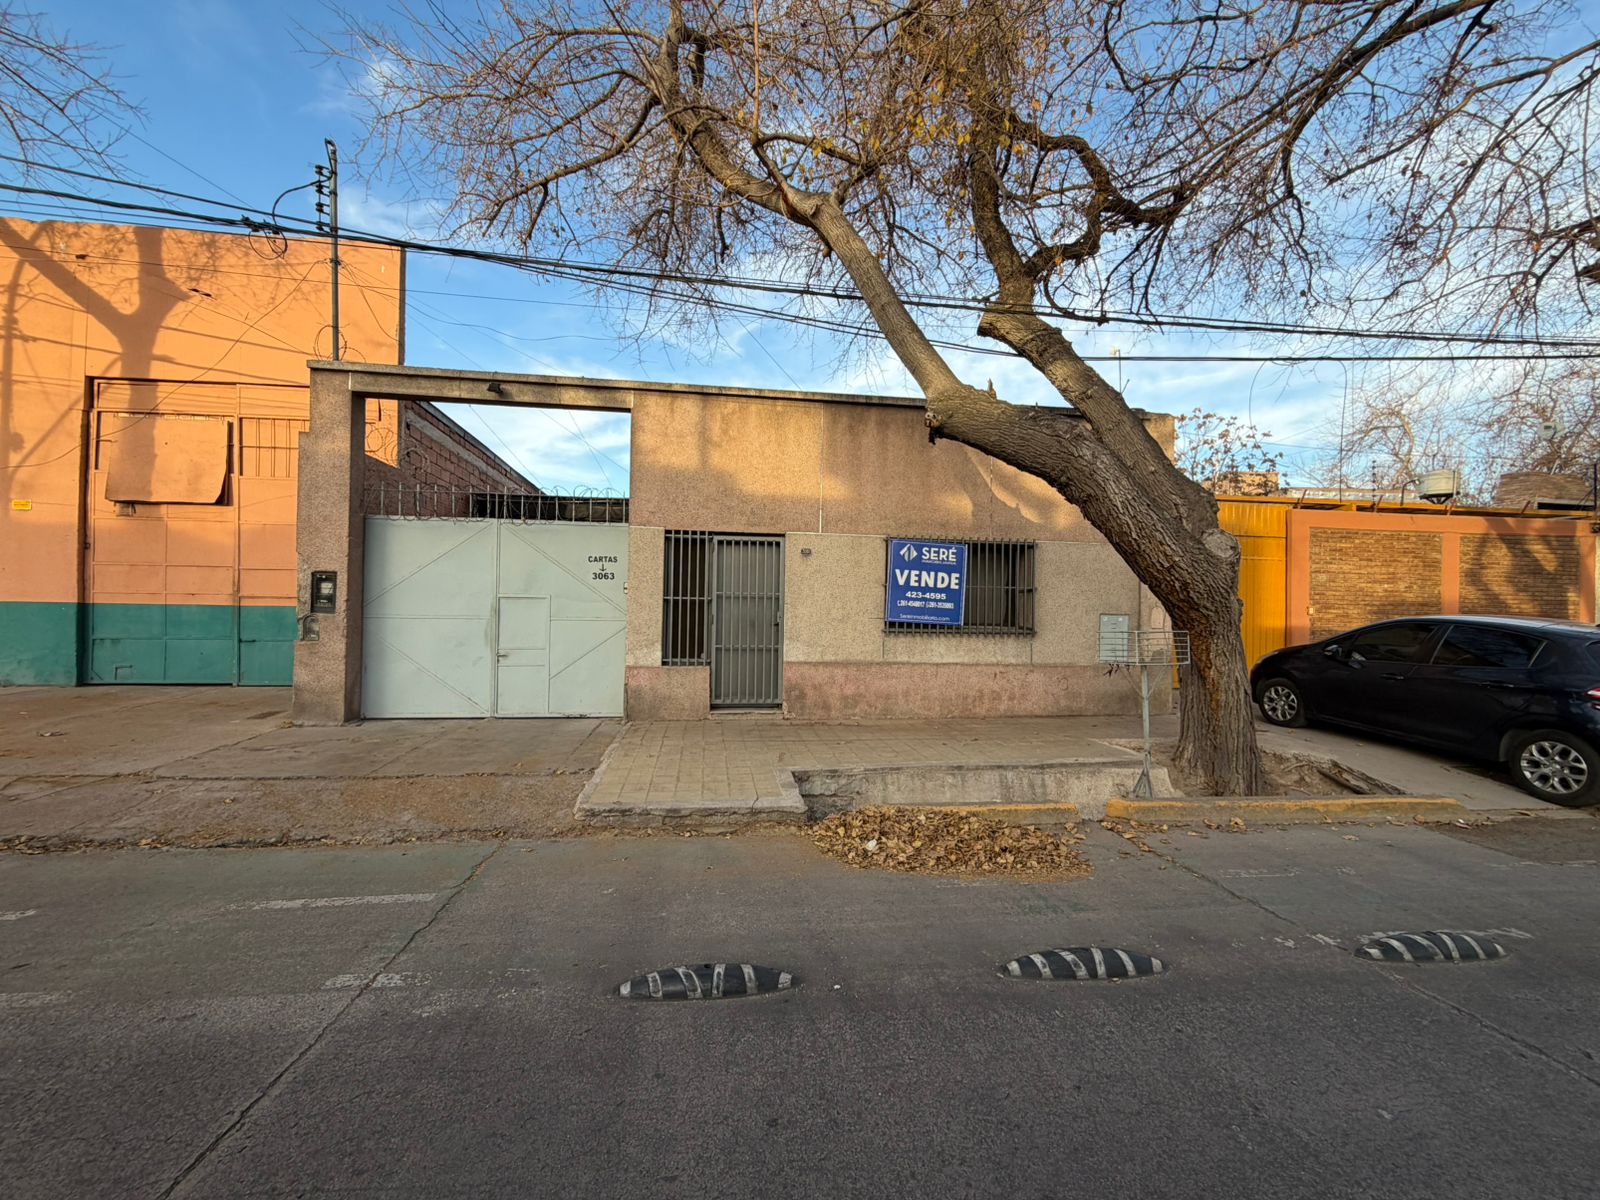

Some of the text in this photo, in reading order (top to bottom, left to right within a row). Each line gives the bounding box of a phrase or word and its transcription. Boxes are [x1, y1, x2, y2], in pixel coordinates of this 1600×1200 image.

[922, 546, 957, 561] SERÉ
[588, 555, 618, 563] CARTAS
[592, 572, 615, 580] 3063
[895, 569, 960, 589] VENDE
[905, 591, 947, 600] 423-4595
